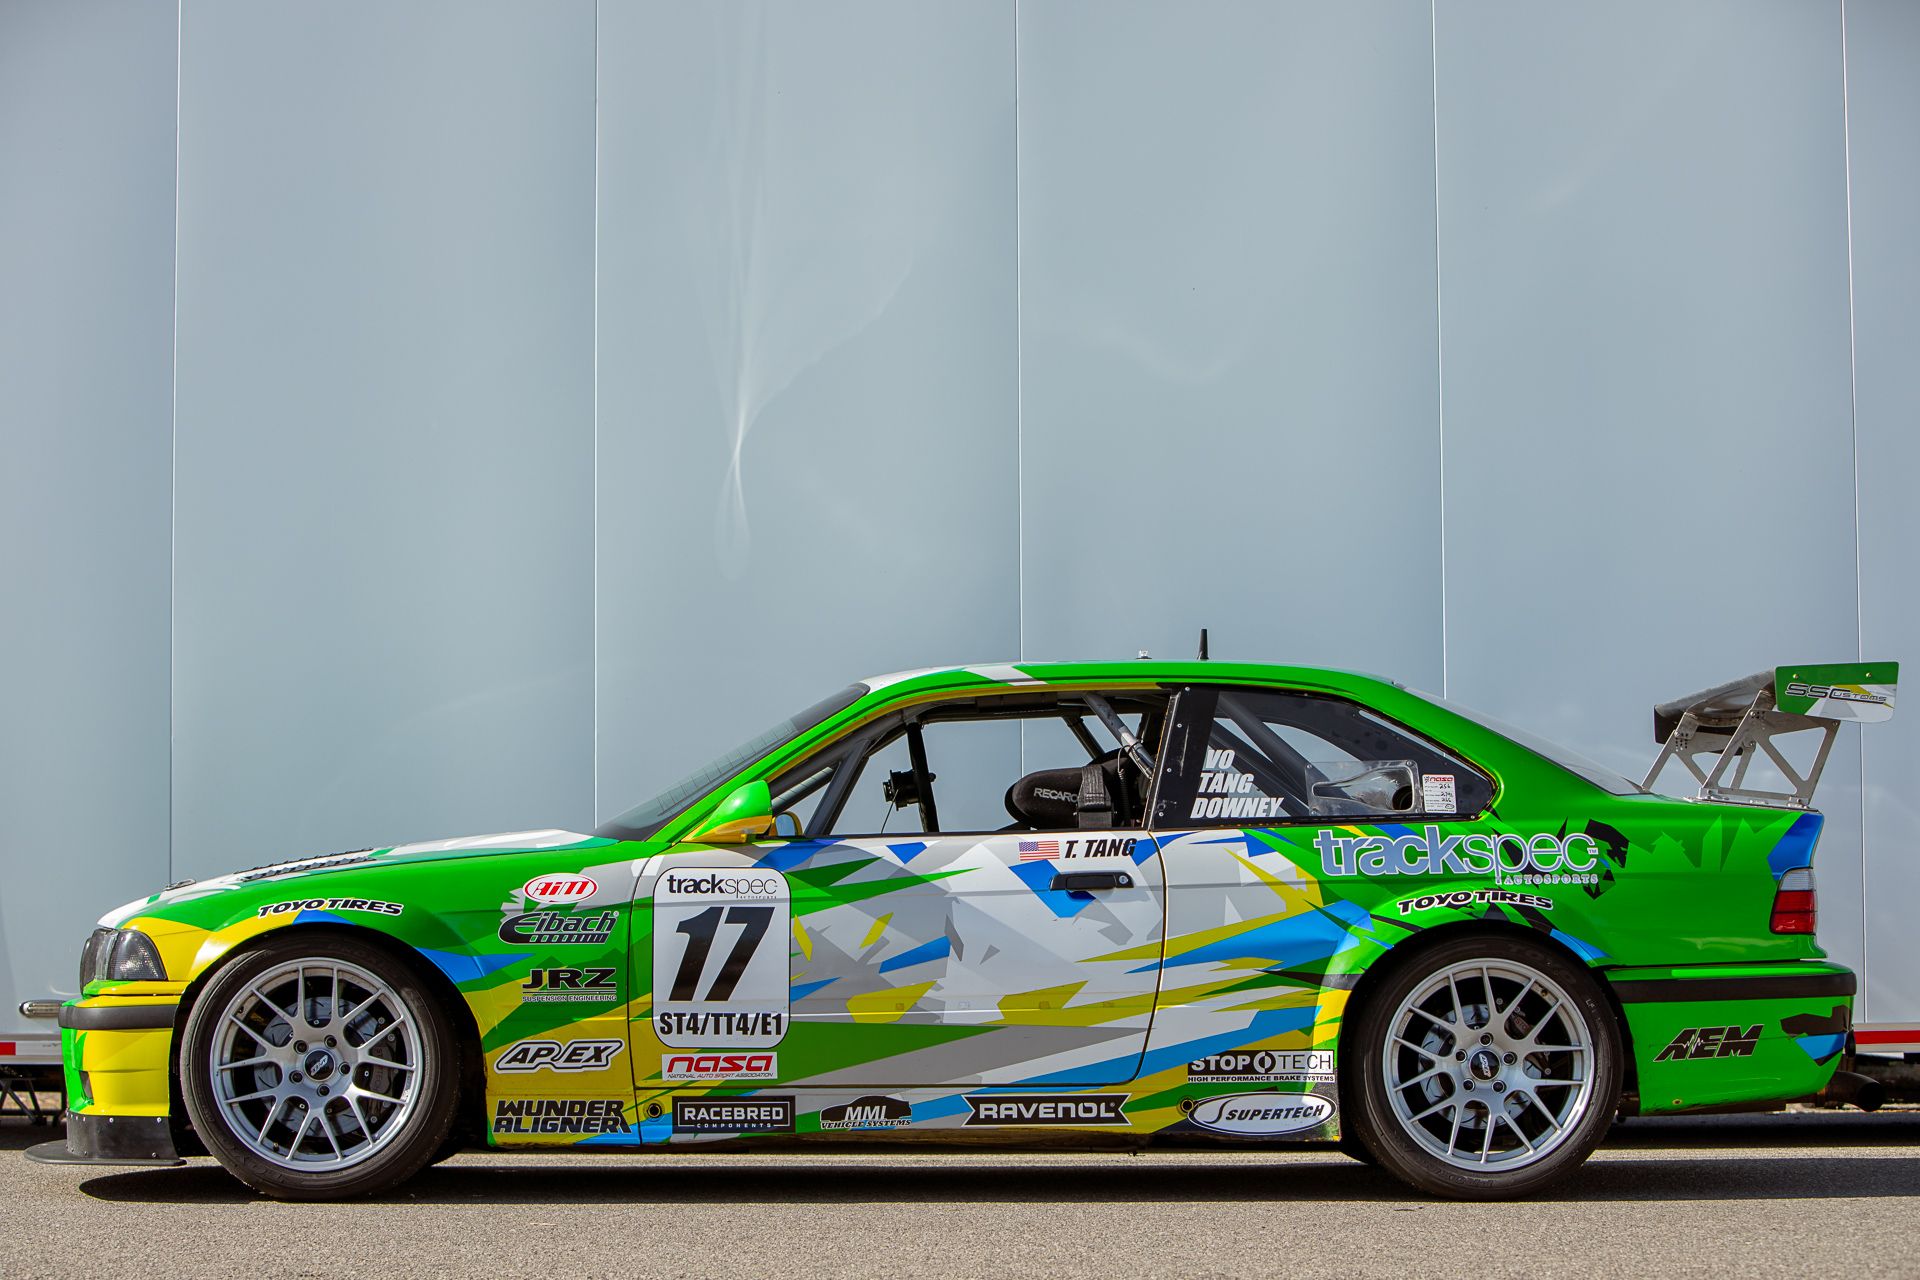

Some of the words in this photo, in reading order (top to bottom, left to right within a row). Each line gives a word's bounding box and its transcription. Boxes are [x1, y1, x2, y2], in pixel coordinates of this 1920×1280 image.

[1205, 749, 1236, 770] VO
[1198, 772, 1255, 794] TANG
[1190, 797, 1285, 819] DOWNEY
[1064, 840, 1079, 859] T.
[1083, 838, 1138, 858] TANG
[1313, 825, 1598, 884] trackspec
[667, 874, 778, 899] trackspec
[1504, 873, 1599, 885] AUTOSPORTS
[498, 911, 617, 944] Eibach
[668, 906, 776, 1002] 17
[522, 968, 616, 989] JRZ
[568, 994, 617, 1002] ENGINEERING
[660, 1012, 781, 1036] ST4/TT4/E1
[1653, 1024, 1764, 1062] AEM
[497, 1100, 625, 1117] WUNDER
[684, 1107, 783, 1120] RACEBRED
[979, 1103, 1115, 1119] RAVENOL
[1226, 1105, 1325, 1121] SUPERTECH
[493, 1117, 632, 1133] ALIGNER
[821, 1121, 865, 1129] VEHICLE
[865, 1119, 912, 1127] SYSTEMS
